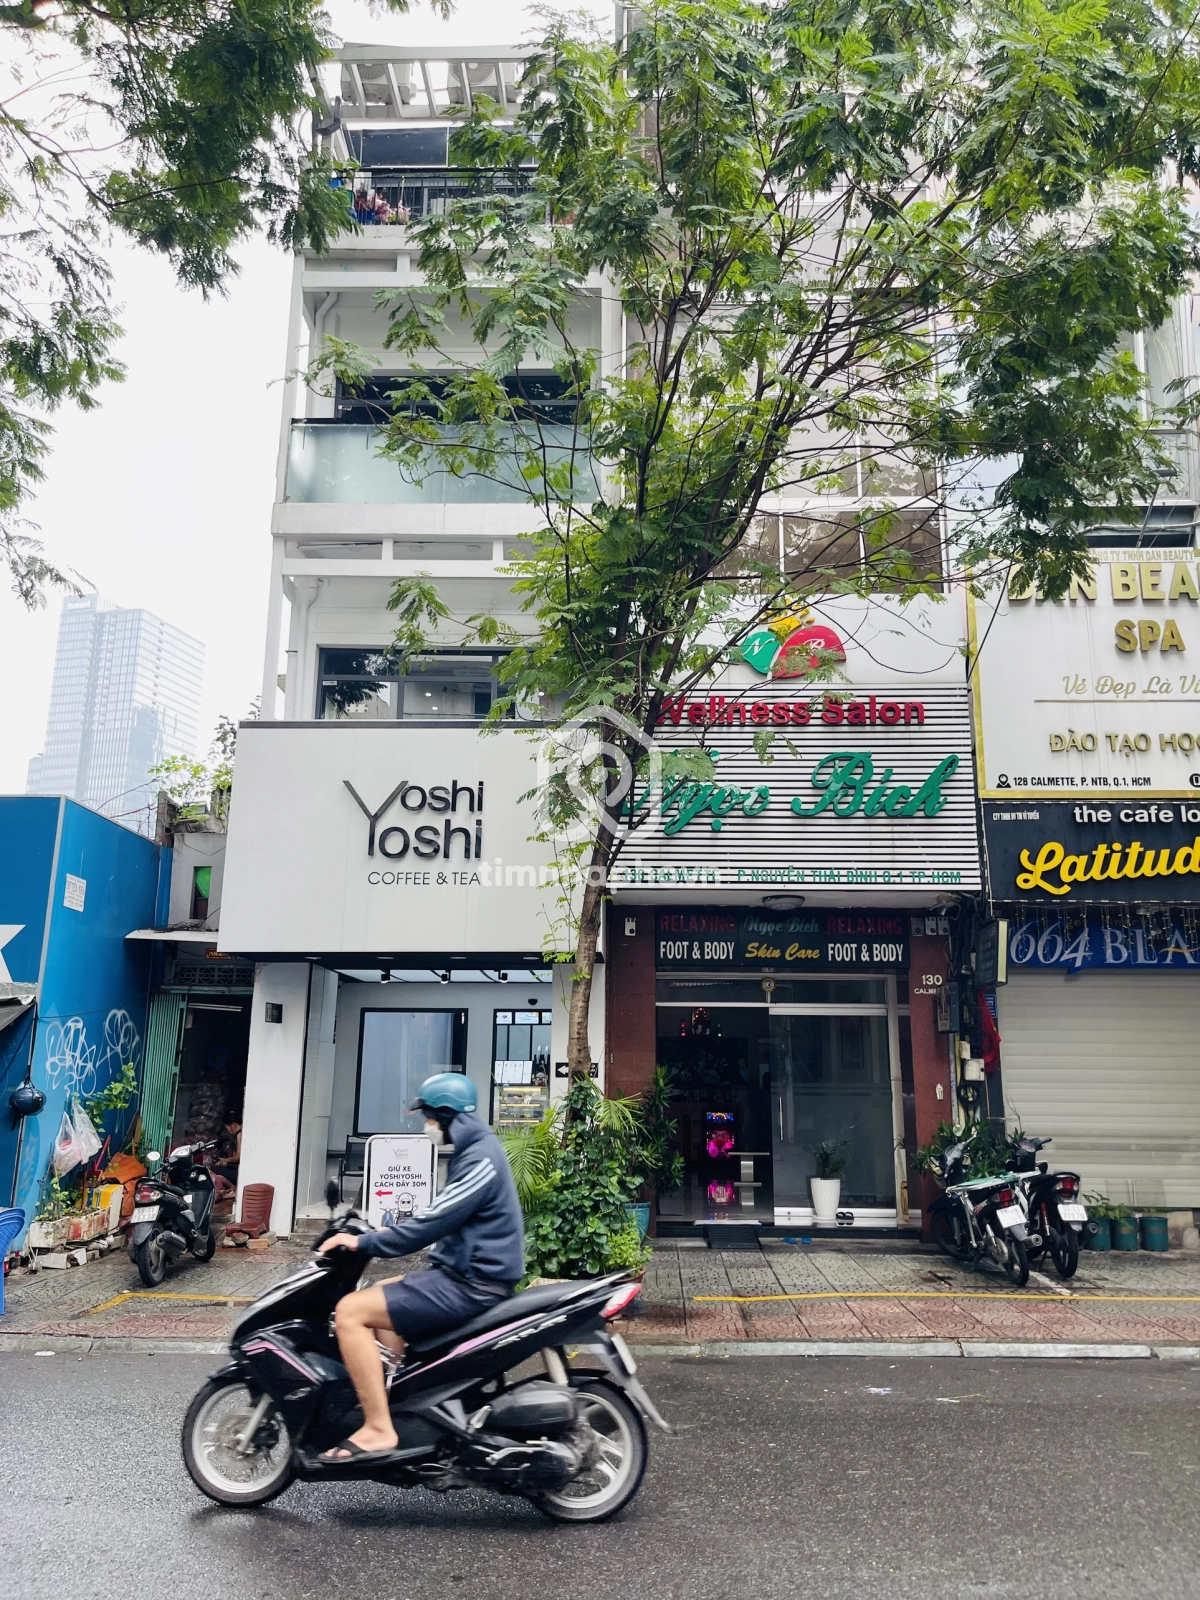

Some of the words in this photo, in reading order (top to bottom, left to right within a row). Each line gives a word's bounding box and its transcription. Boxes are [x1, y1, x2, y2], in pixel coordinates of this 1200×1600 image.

[1110, 550, 1121, 561] TY
[1122, 550, 1144, 561] TNHH
[1145, 549, 1161, 561] DAN
[1162, 549, 1195, 561] BEAUTY
[1110, 562, 1200, 601] BEA
[1114, 618, 1187, 653] SPA
[1062, 674, 1088, 695] Vẻ
[1095, 675, 1137, 699] Đẹp
[1142, 675, 1173, 695] Là
[821, 694, 926, 725] Salon
[1049, 728, 1098, 752] ĐÀO
[1105, 732, 1152, 757] TẠO
[791, 750, 961, 818] Bích
[1013, 776, 1029, 787] 128
[1030, 776, 1079, 788] CALMETTE,
[1081, 777, 1089, 787] P.
[1091, 777, 1111, 788] NTB,
[1113, 777, 1130, 788] Q.1,
[1132, 776, 1152, 787] HCM
[342, 779, 485, 814] Yoshi
[1074, 805, 1111, 823] the
[1119, 805, 1175, 823] cafe
[366, 818, 483, 860] Yoshi
[367, 870, 430, 886] COFFEE
[436, 871, 448, 886] &
[452, 871, 481, 886] TEA
[650, 868, 721, 882] CALMETTE
[737, 864, 806, 883] P.NGUYỄN
[811, 867, 841, 884] THÁI
[846, 866, 878, 884] BÌNH
[909, 870, 962, 884] TP.HCM
[659, 913, 735, 934] RELAXING
[743, 914, 784, 937] Ngọc
[787, 915, 821, 934] Bích
[827, 915, 904, 935] RELAXING
[659, 940, 689, 960] FOOT
[692, 941, 701, 960] &
[704, 941, 735, 960] BODY
[744, 941, 781, 959] Skin
[784, 942, 821, 961] Care
[827, 943, 857, 962] FOOT
[860, 943, 870, 962] &
[872, 943, 904, 962] BODY
[1009, 920, 1094, 968] 664
[921, 974, 943, 986] 130
[374, 1180, 394, 1188] CÁCH
[396, 1180, 410, 1188] ĐÂY
